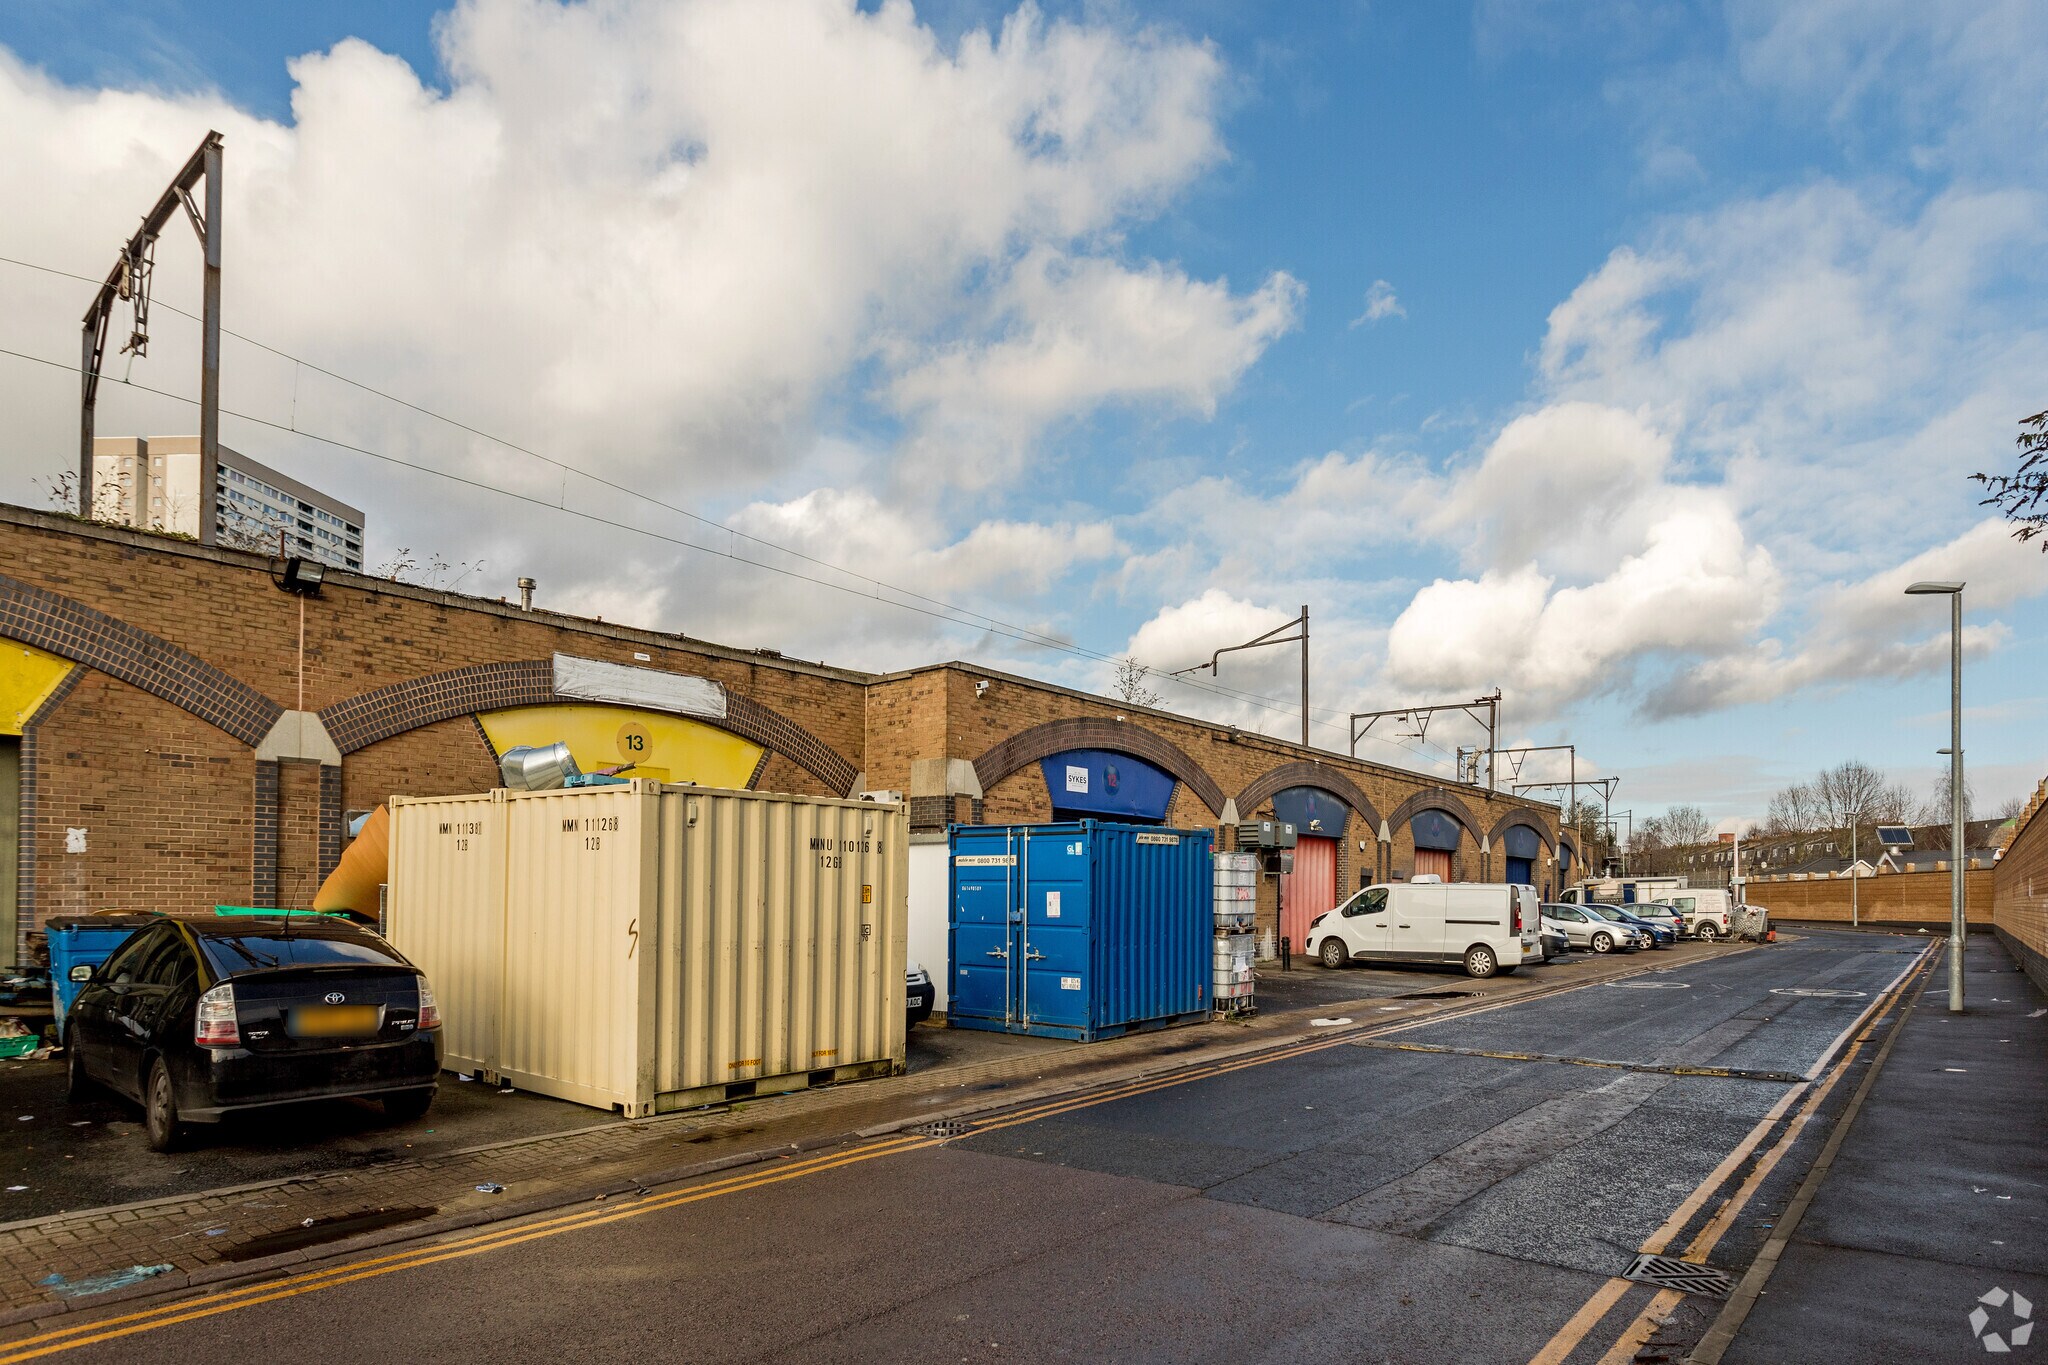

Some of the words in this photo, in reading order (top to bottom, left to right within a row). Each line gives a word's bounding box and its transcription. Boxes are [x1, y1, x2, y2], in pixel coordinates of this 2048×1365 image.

[625, 735, 644, 751] 13
[1068, 774, 1087, 785] SYKES
[1107, 773, 1118, 787] 12
